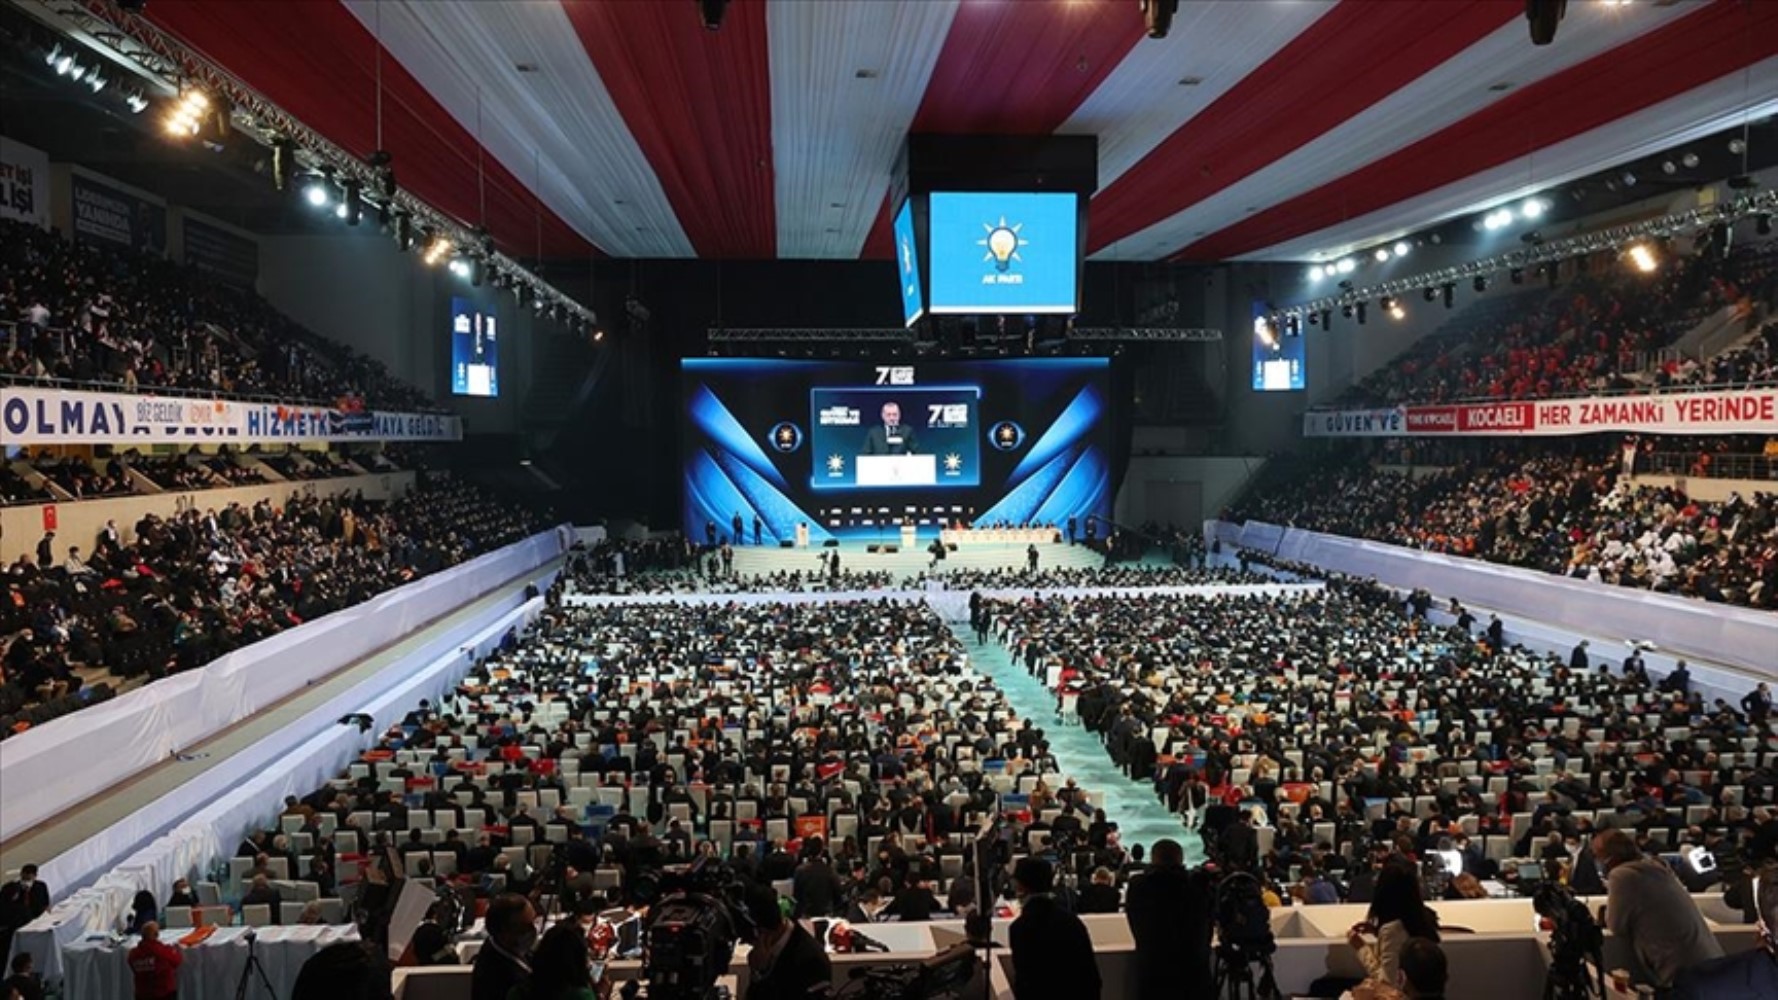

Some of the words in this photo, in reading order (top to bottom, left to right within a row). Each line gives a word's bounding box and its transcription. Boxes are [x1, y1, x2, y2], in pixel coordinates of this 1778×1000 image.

[1467, 405, 1524, 426] KOCAELİ
[1540, 405, 1571, 425] HER
[1675, 395, 1774, 422] YERİNDE
